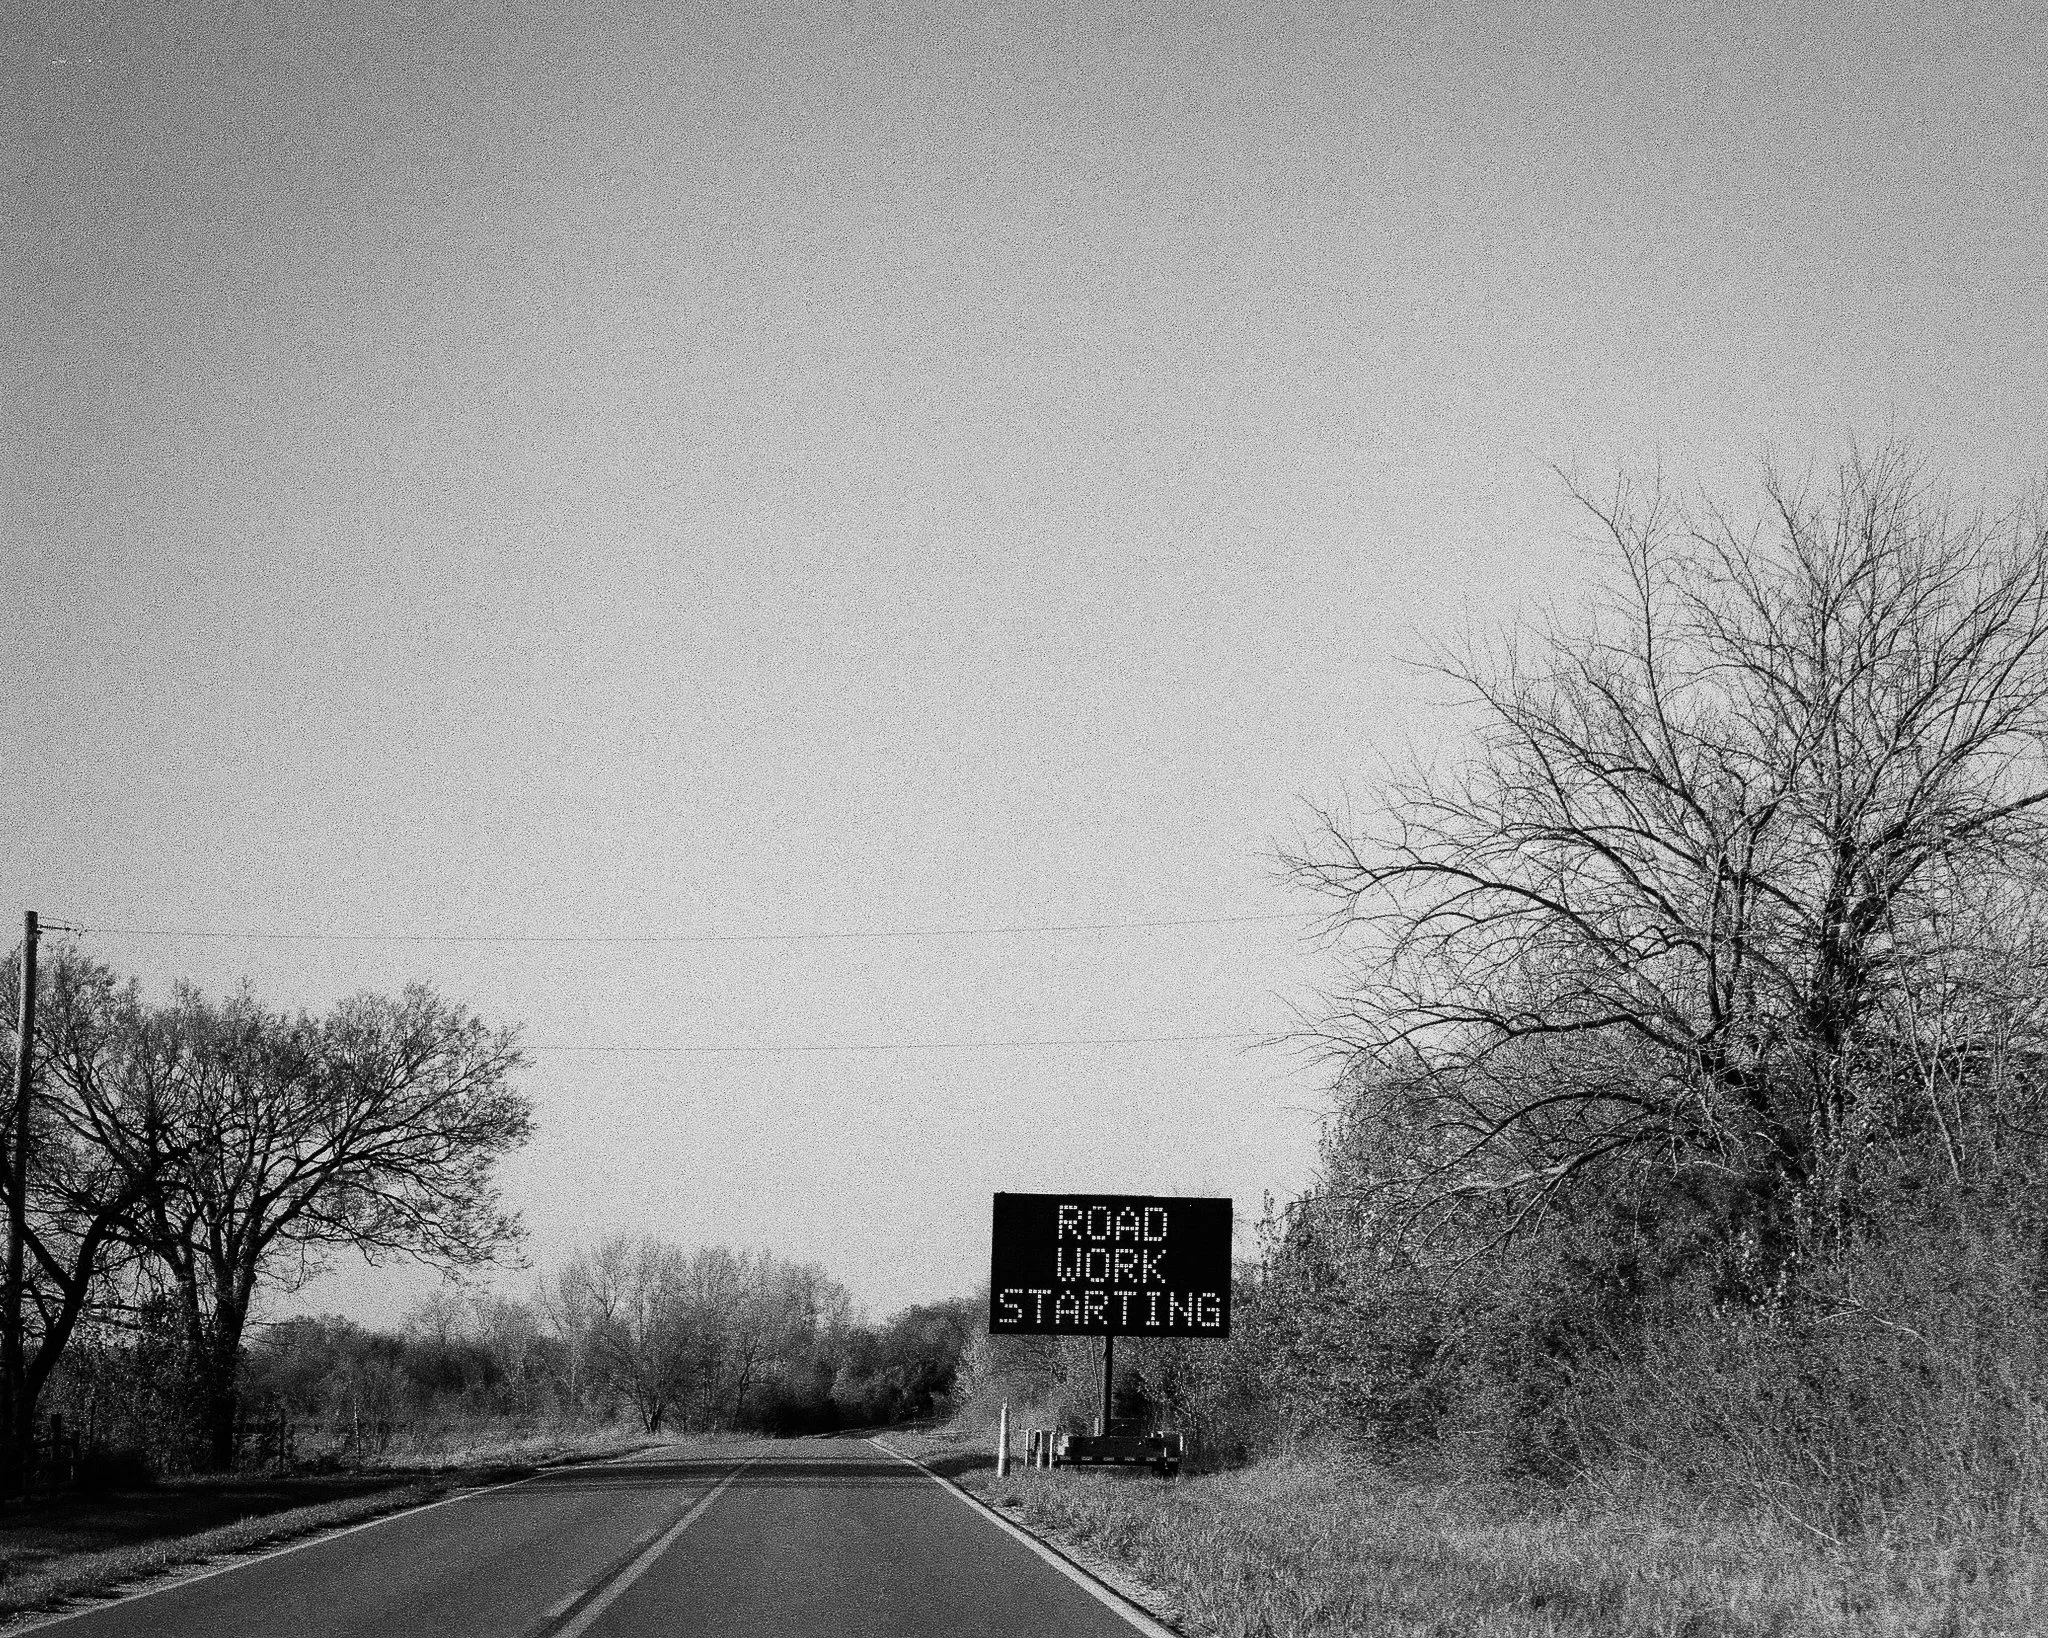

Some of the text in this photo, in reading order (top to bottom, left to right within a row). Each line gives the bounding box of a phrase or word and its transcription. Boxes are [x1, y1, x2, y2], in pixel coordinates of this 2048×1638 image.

[1058, 1204, 1168, 1242] ROAD
[1056, 1247, 1167, 1284] WORK
[999, 1288, 1221, 1327] STARTING
